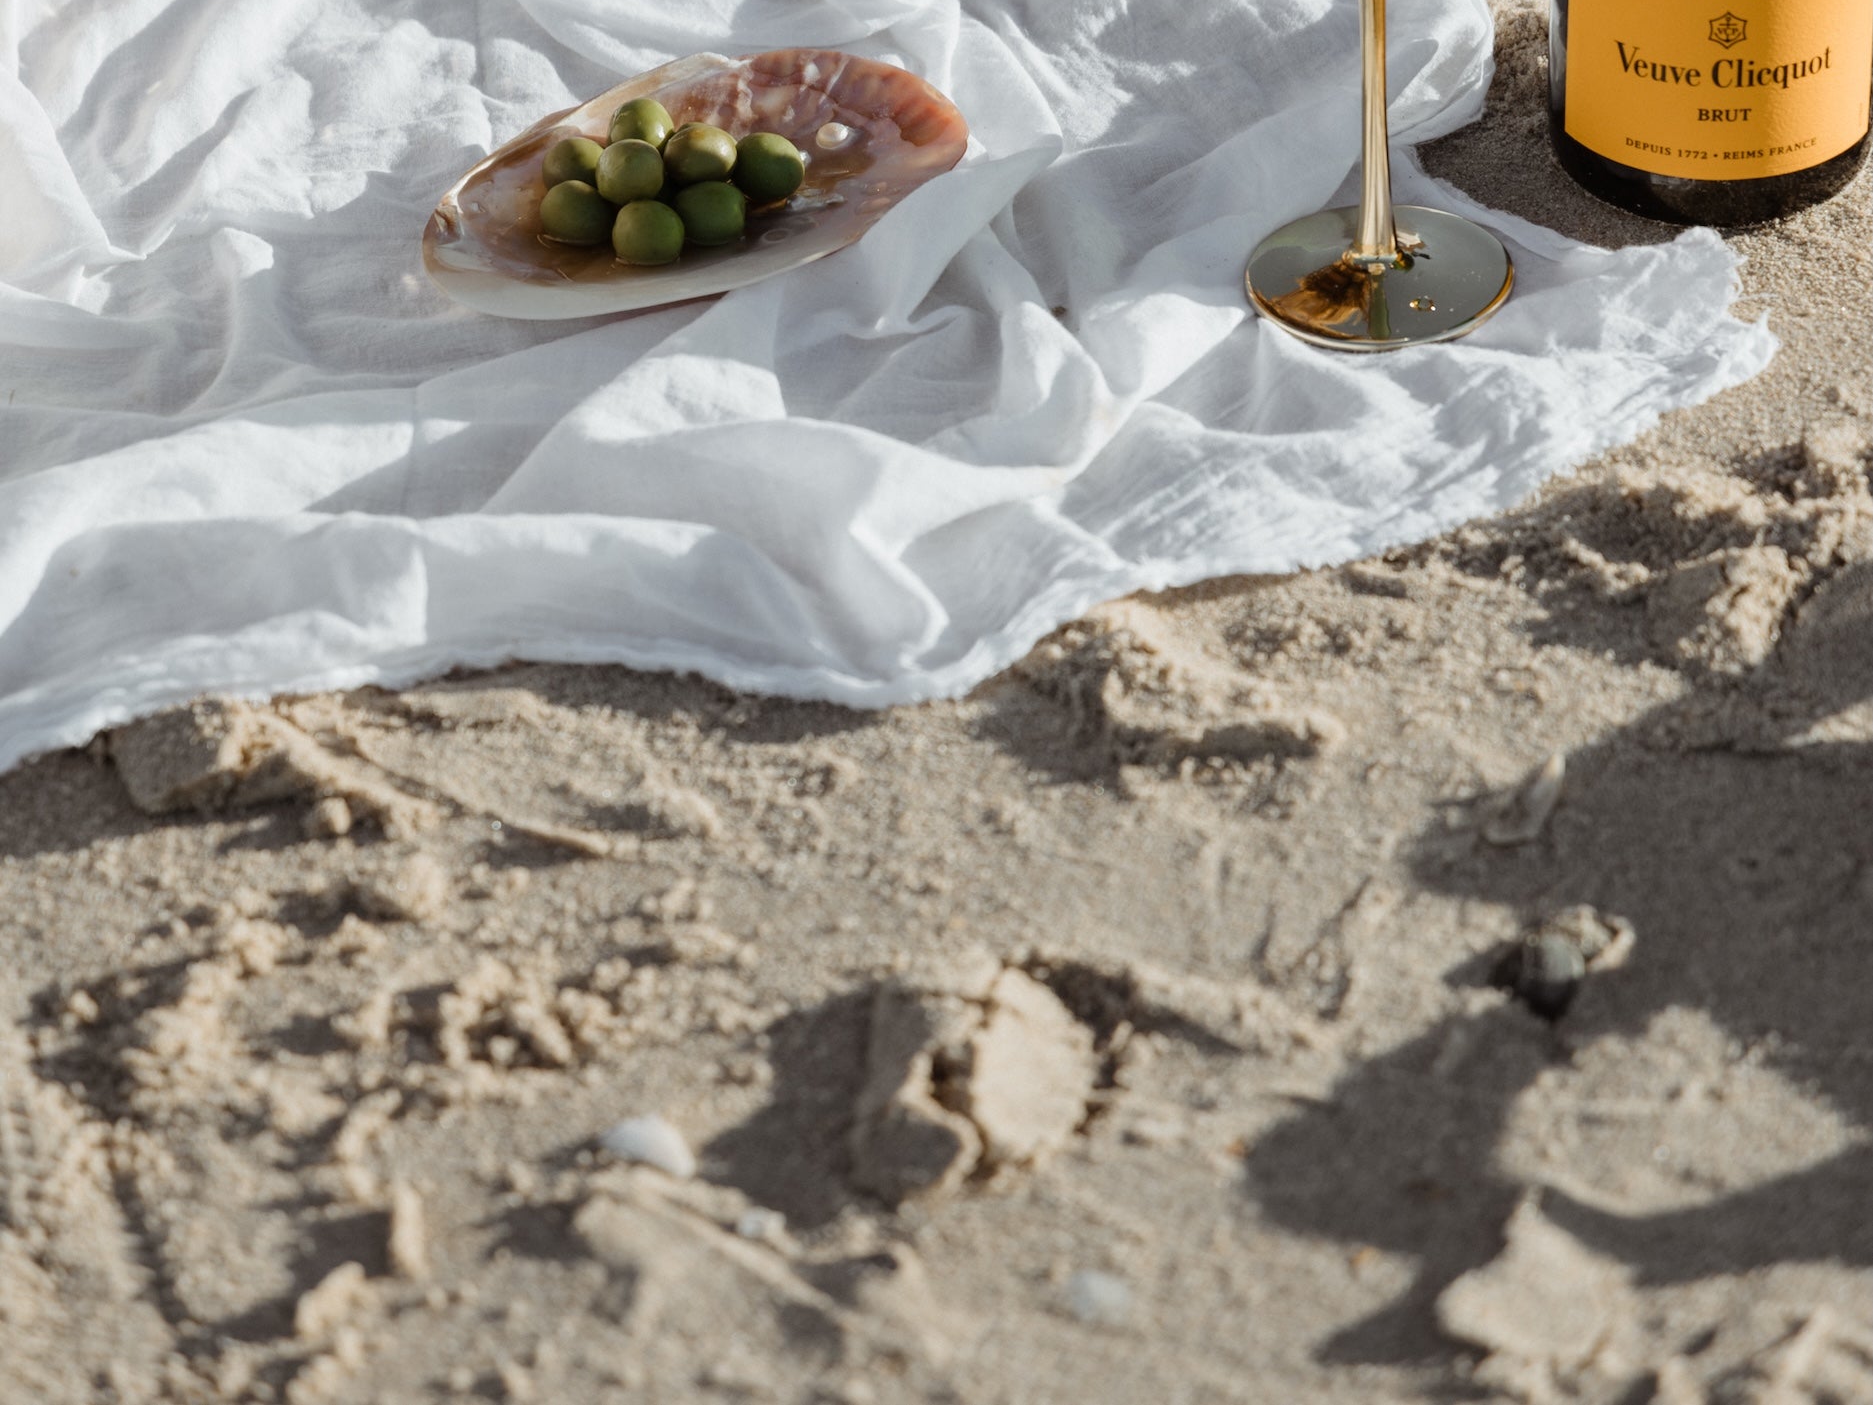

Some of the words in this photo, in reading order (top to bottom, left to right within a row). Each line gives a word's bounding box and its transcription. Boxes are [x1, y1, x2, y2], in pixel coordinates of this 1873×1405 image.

[1615, 39, 1702, 88] Veuve
[1711, 46, 1832, 89] Clicquot
[1697, 108, 1752, 122] BRUT
[1625, 137, 1672, 156] DEPUIS
[1678, 148, 1709, 160] 1772
[1723, 149, 1764, 161] REIMS
[1769, 137, 1817, 157] FRANCE
